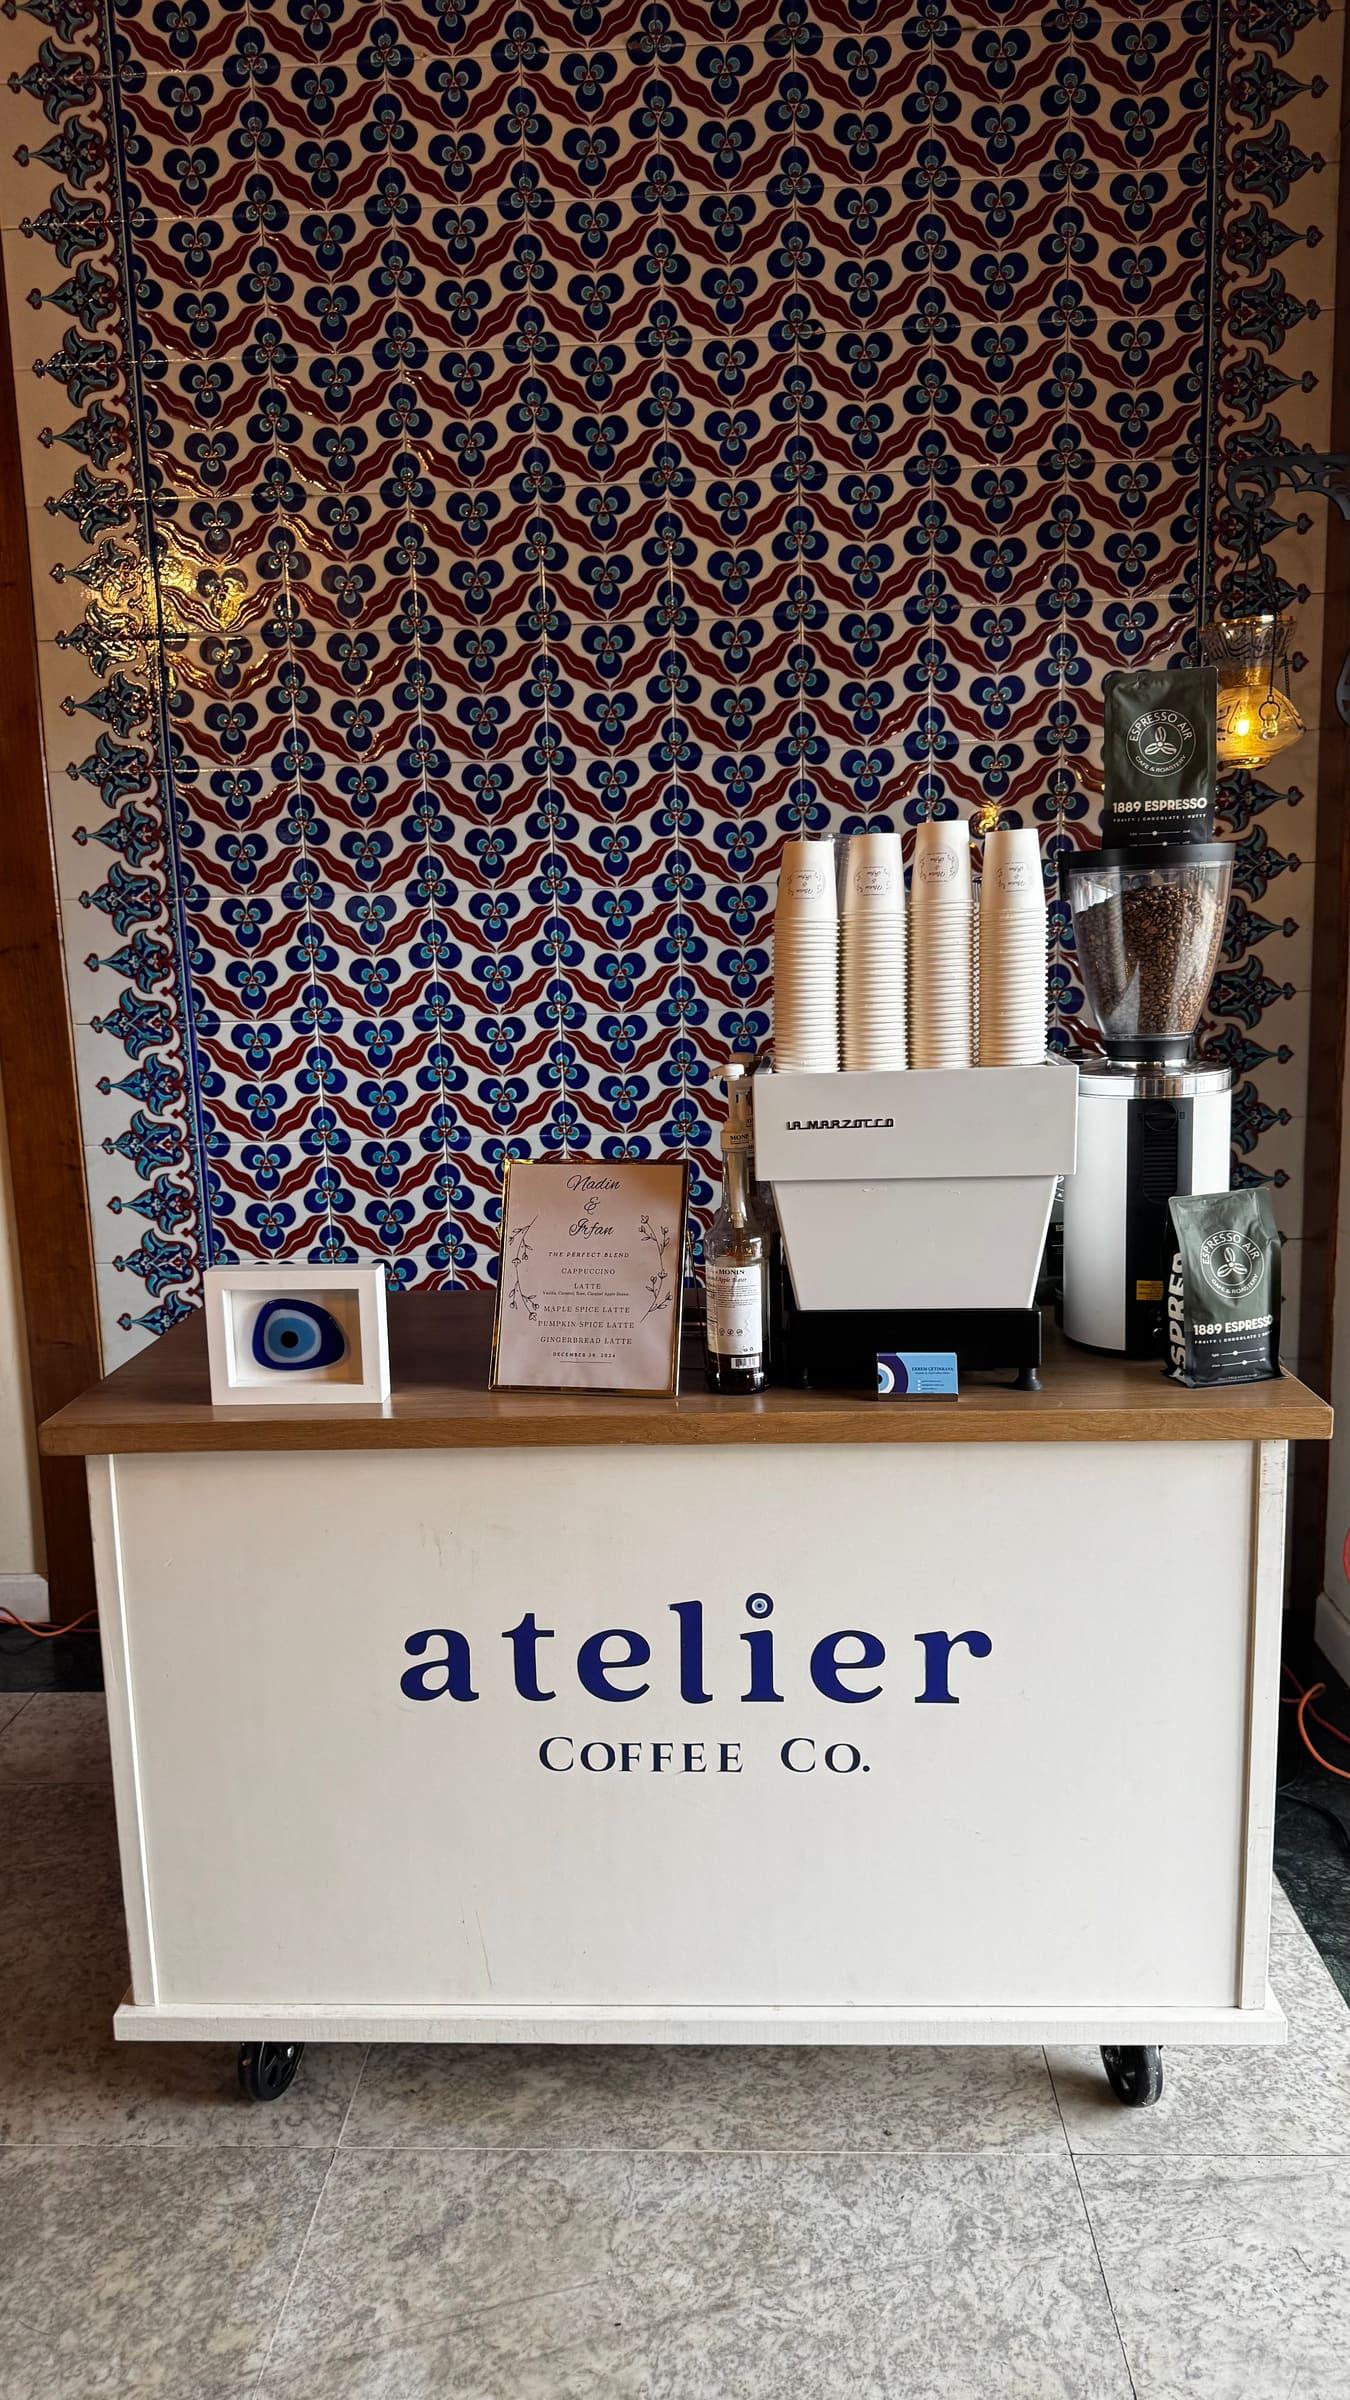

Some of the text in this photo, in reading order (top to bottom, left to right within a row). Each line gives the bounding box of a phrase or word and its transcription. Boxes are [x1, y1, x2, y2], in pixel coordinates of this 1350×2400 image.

[1128, 711, 1194, 742] ESPRESSO AIR
[1155, 754, 1187, 773] ROASTERY
[1112, 796, 1208, 813] 1889 ESPRESSO
[786, 1120, 801, 1130] LA
[566, 1174, 621, 1191] Nadin
[583, 1196, 601, 1216] &
[568, 1217, 615, 1240] Irfan
[1202, 1232, 1261, 1265] ESPRESSO AIR
[560, 1267, 616, 1275] CAPPUCCINO
[573, 1282, 602, 1290] LATTE
[543, 1305, 573, 1313] MAPLE
[602, 1306, 631, 1314] LATTE
[538, 1320, 577, 1328] PUMPKIN
[1193, 1323, 1222, 1336] 1889
[1224, 1314, 1274, 1334] ESPRESSO
[540, 1336, 632, 1345] GINGERBREAD LATTE
[400, 1592, 993, 1704] atelier
